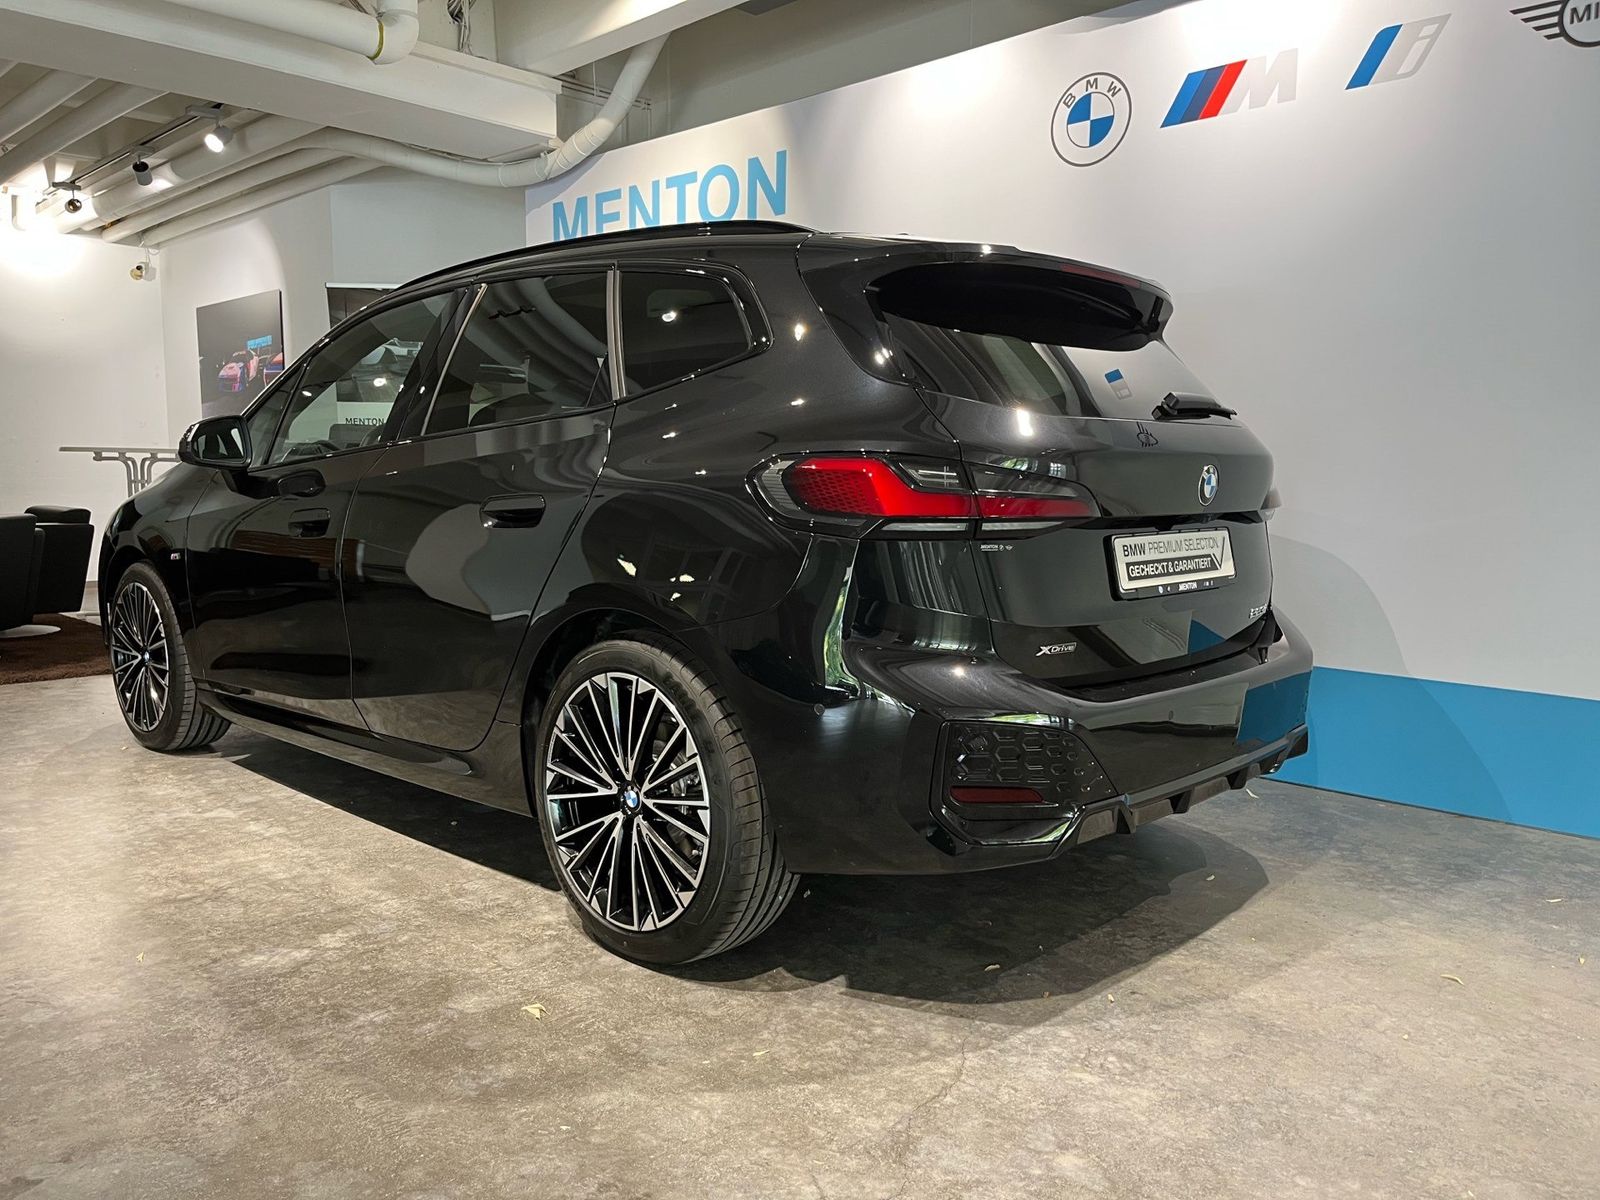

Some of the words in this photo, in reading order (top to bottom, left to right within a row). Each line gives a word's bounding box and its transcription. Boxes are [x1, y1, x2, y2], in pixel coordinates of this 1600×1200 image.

[1062, 77, 1122, 109] BMW
[552, 149, 788, 243] MENTON
[345, 417, 385, 426] MENTON
[1122, 543, 1146, 557] BMW
[1148, 538, 1184, 554] PREMIUM
[1185, 536, 1219, 551] SELECTION
[1129, 562, 1168, 577] GECHECKT
[1168, 562, 1174, 573] &
[1174, 557, 1212, 571] GARANTIERT
